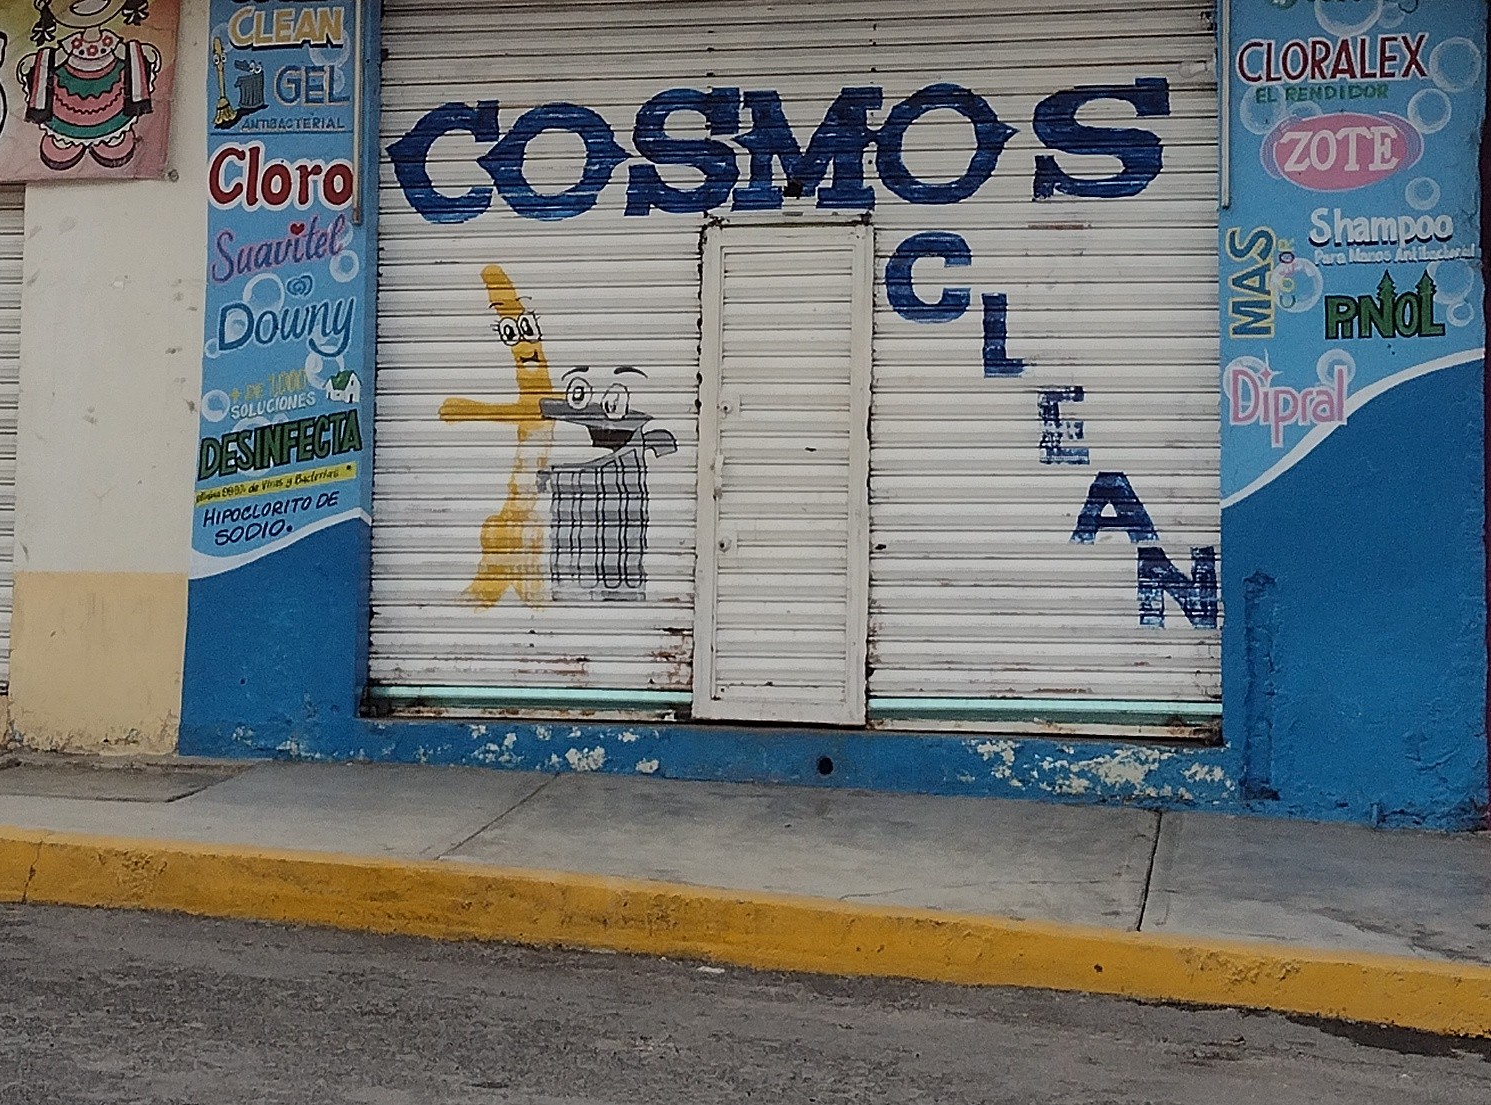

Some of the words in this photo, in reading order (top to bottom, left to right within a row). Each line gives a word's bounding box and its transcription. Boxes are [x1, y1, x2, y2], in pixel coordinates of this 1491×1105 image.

[228, 6, 345, 48] CLEAN
[274, 63, 350, 107] GEL
[1236, 33, 1429, 84] CLORALEX
[1255, 87, 1277, 103] EL
[207, 140, 354, 211] Cloro
[386, 77, 1171, 224] COSMOS
[1280, 125, 1399, 173] ZOTE
[211, 215, 348, 284] Suavitel
[1309, 207, 1453, 248] Shampoo
[1228, 226, 1277, 339] MAS
[1314, 249, 1347, 267] Para
[217, 296, 357, 358] Downy
[884, 231, 1220, 630] CLEAN
[1229, 365, 1348, 448] Dipral
[197, 409, 363, 482] DESINFECTA
[203, 496, 313, 528] HIPOCLORITO
[316, 490, 340, 509] DE
